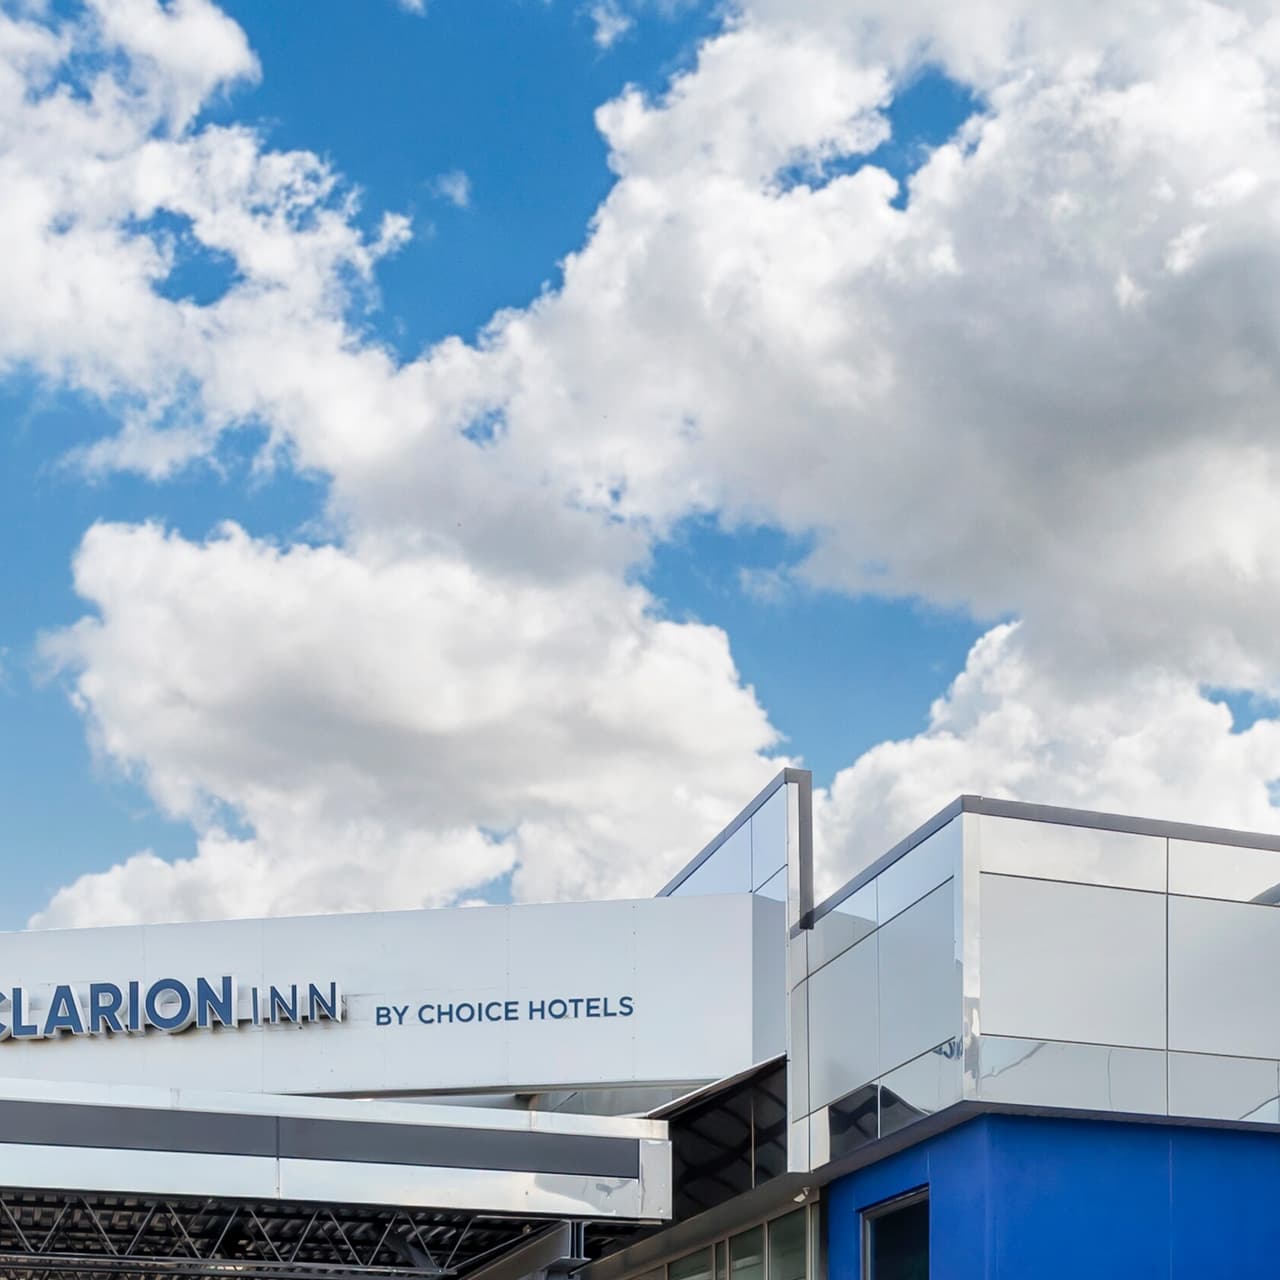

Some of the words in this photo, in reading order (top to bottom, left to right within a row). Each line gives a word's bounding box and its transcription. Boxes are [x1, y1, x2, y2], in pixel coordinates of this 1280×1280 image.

[251, 981, 339, 1025] INN
[375, 1005, 410, 1026] BY
[418, 1001, 520, 1025] CHOICE
[528, 996, 635, 1021] HOTELS
